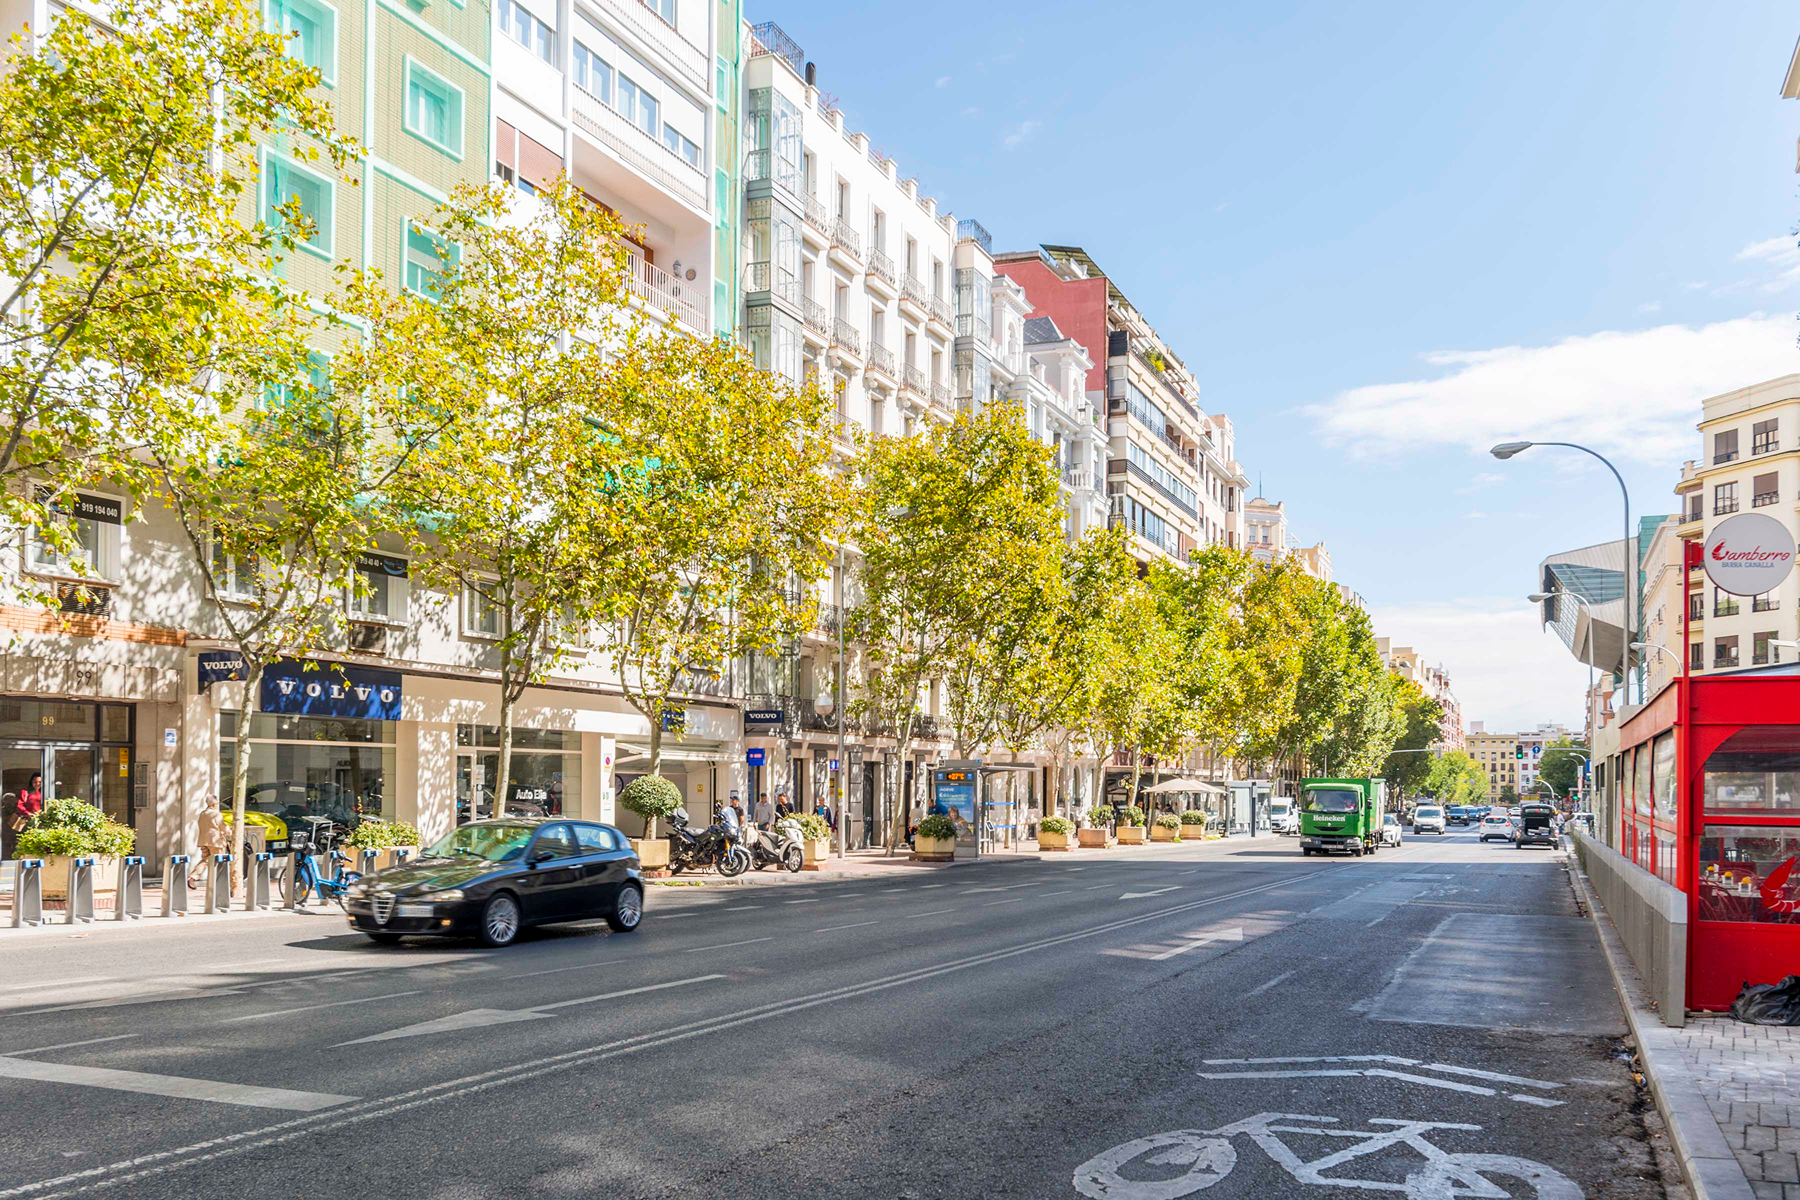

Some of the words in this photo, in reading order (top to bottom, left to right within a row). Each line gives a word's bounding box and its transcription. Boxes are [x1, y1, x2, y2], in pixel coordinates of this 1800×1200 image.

[82, 502, 93, 512] 919
[95, 505, 105, 515] 194
[107, 508, 118, 517] 040
[203, 660, 243, 670] VOLVO
[76, 670, 92, 686] 99
[277, 680, 394, 703] VOLVO
[42, 716, 54, 726] 99
[516, 789, 533, 800] Auto
